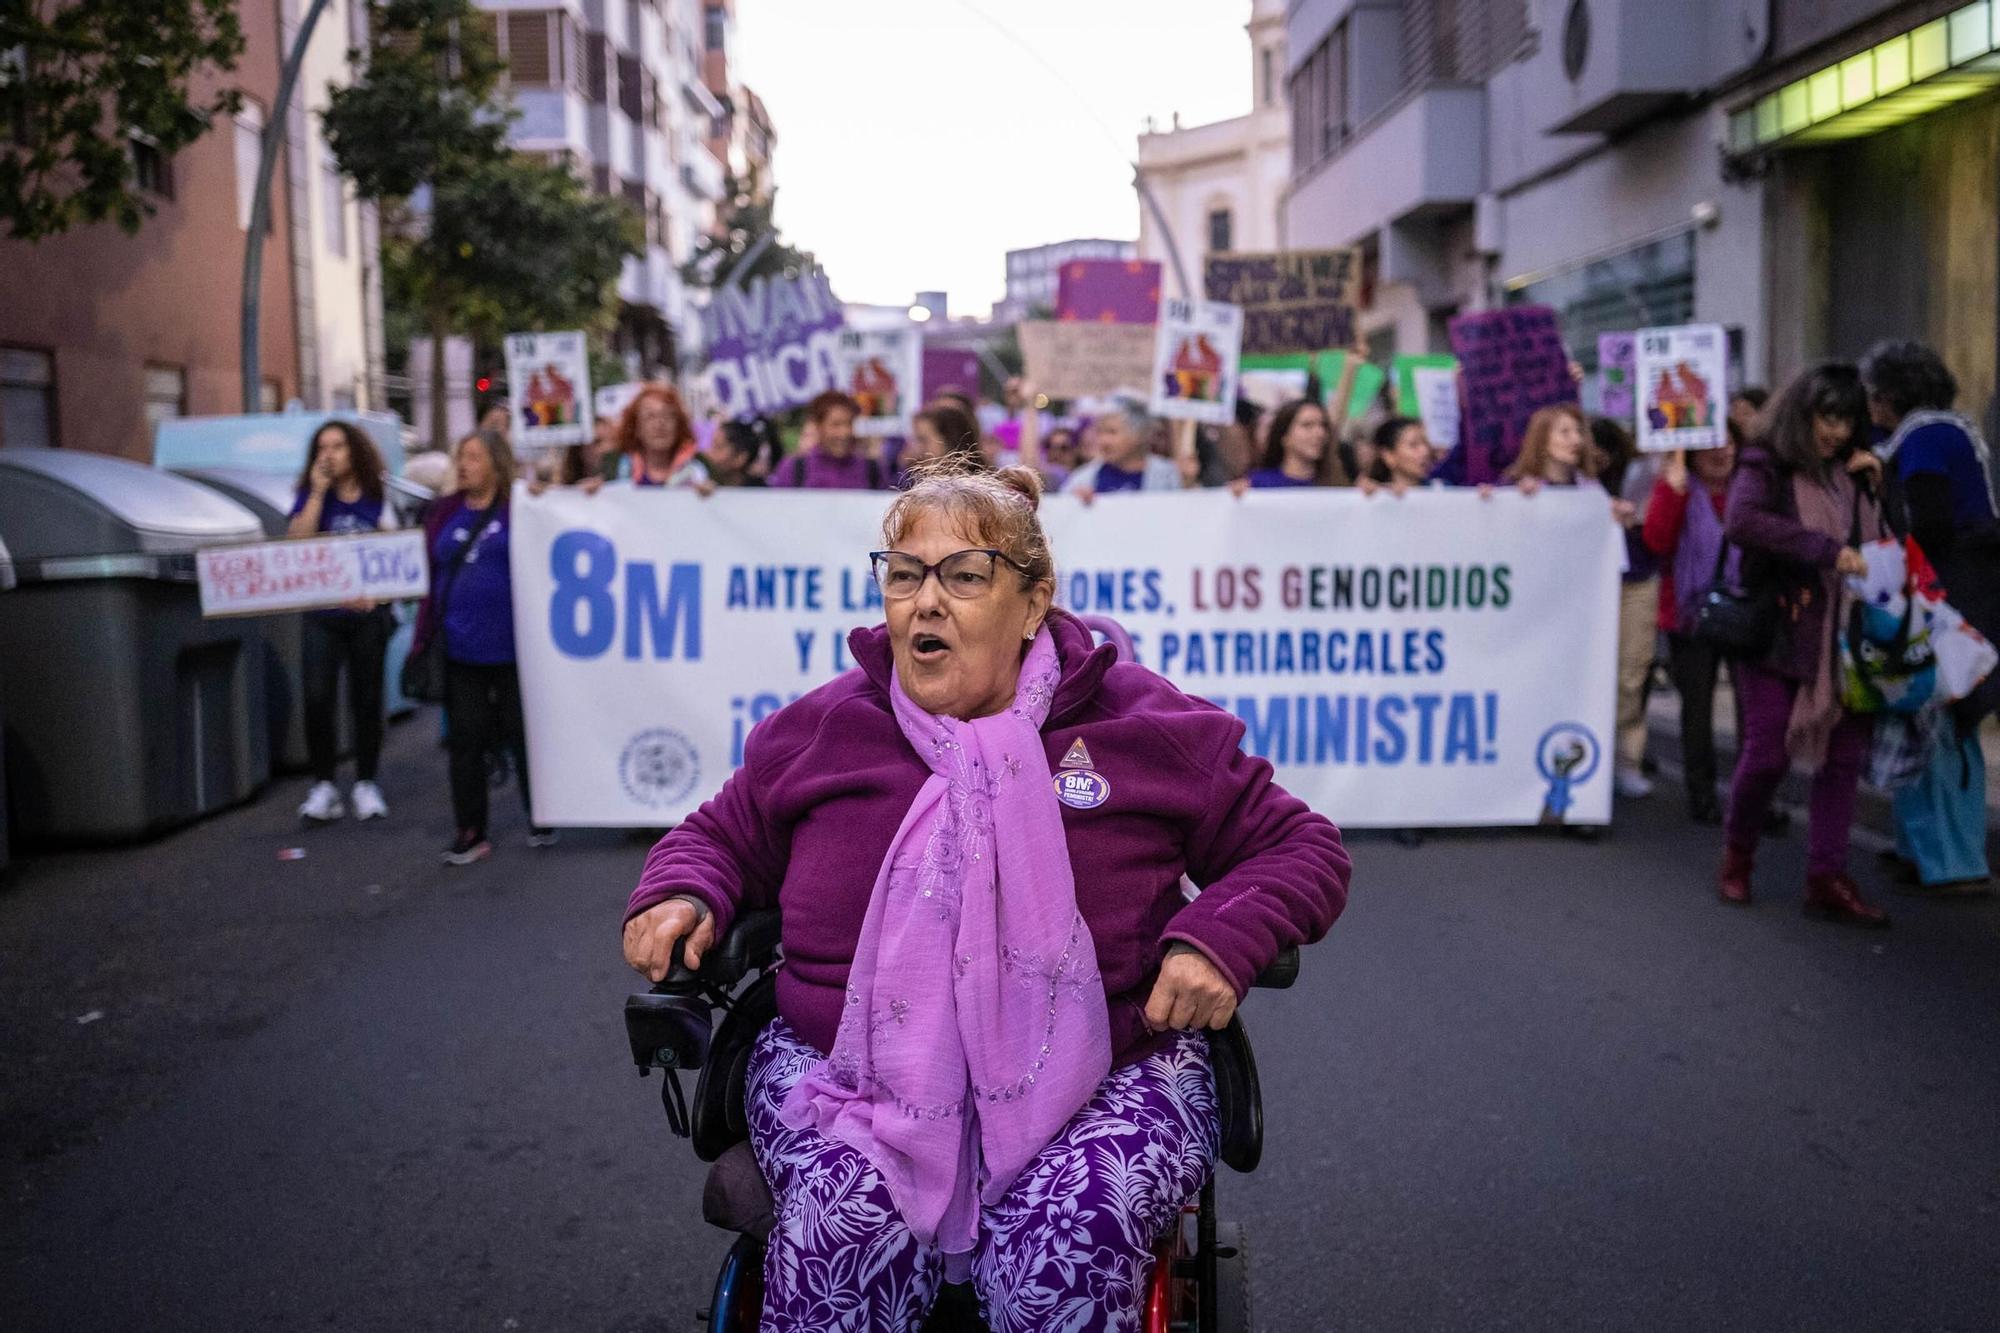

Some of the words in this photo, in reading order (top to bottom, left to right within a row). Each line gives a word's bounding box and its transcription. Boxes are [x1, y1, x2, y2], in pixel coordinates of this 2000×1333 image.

[550, 529, 703, 660] 8M
[728, 567, 822, 610] ANTE
[1192, 567, 1262, 611] LOS
[1281, 566, 1512, 611] GENOCIDIOS
[796, 632, 815, 672] Y
[1161, 631, 1445, 674] PATRIARCALES
